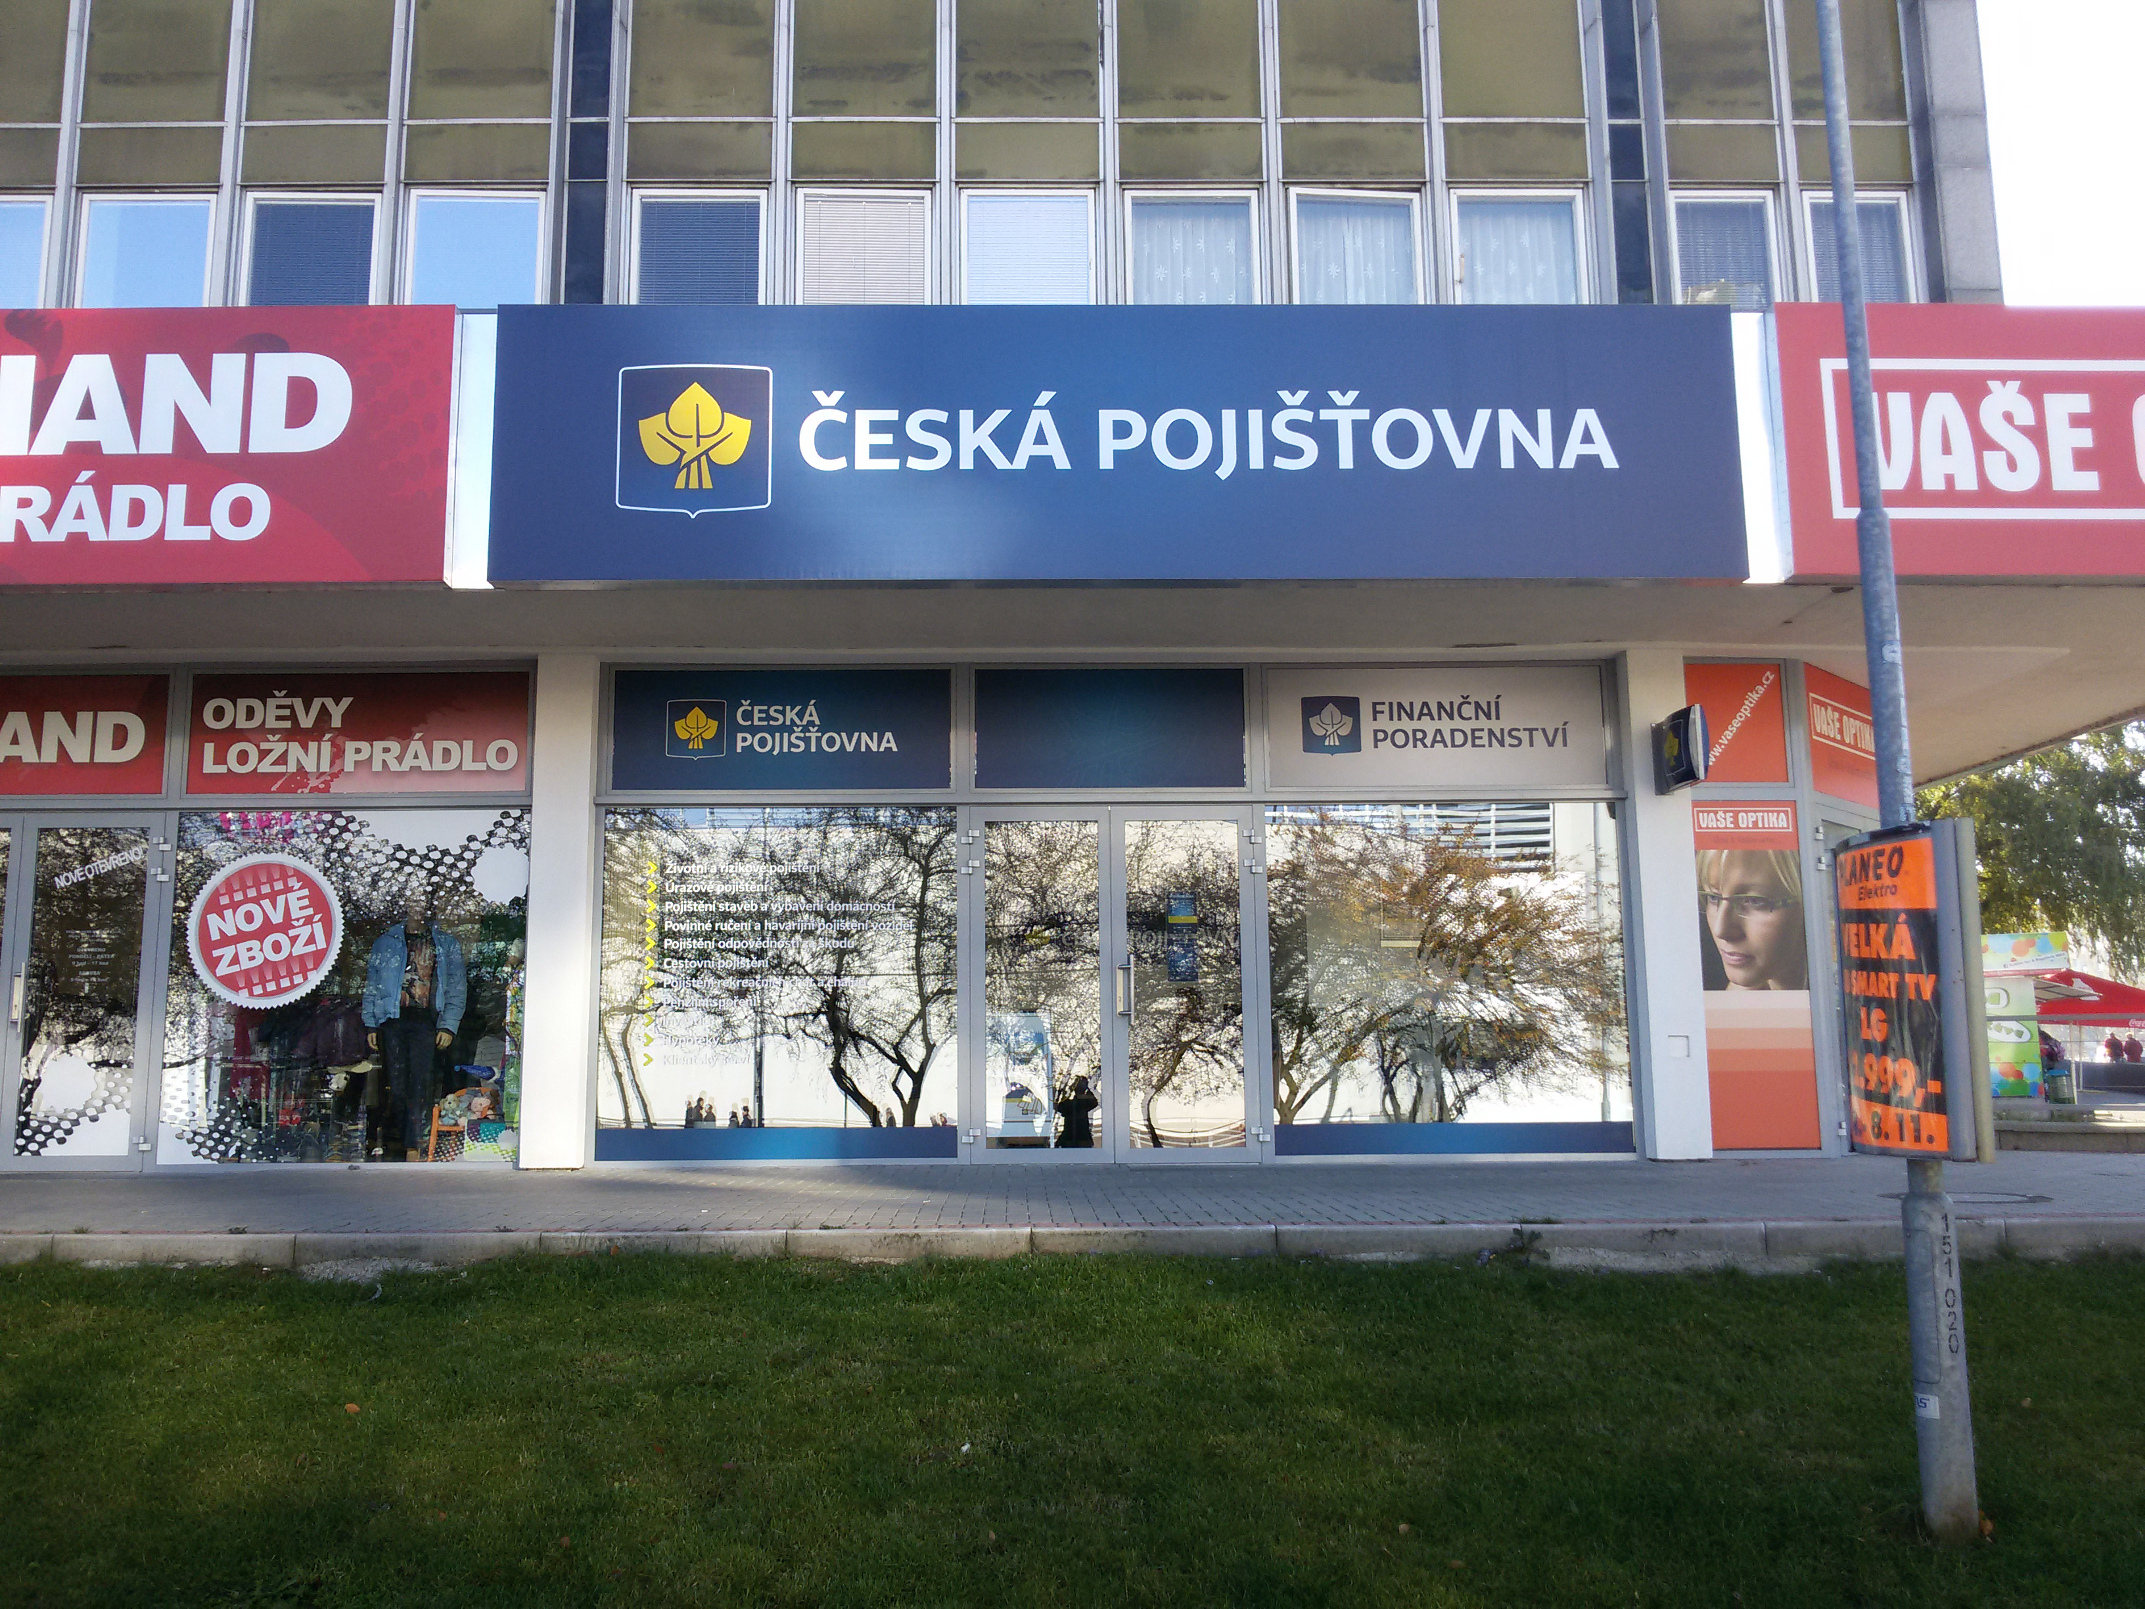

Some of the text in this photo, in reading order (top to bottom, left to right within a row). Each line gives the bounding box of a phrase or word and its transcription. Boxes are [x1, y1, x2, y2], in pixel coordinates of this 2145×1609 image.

[799, 390, 1621, 481] ČESKÁ POJIŠŤOVNA
[1871, 380, 2100, 492] VAŠE
[203, 690, 353, 730] ODĚVY
[736, 700, 820, 727] ČESKÁ
[1371, 694, 1502, 722] FINANČNÍ
[1372, 721, 1569, 750] PORADENSTVÍ
[1813, 704, 1841, 740] VAŠE
[202, 732, 519, 774] LOŽNÍ PRÁDLO
[736, 728, 899, 755] POJIŠŤOVNA
[1698, 811, 1787, 828] VAŠE OPTIKA
[665, 860, 708, 873] Životní
[721, 861, 767, 873] rizikové
[770, 861, 820, 876] pojištění
[665, 880, 768, 895] Úrazové pojištění
[1858, 883, 1898, 901] Elektro
[205, 882, 315, 942] NOVÉ
[664, 901, 716, 914] Pojištění
[719, 901, 757, 912] staveb
[664, 920, 712, 931] Povinné
[715, 920, 752, 931] ručení
[764, 920, 815, 933] havarijní
[818, 919, 868, 933] pojištění
[211, 913, 328, 977] ZBOŽÍ
[664, 938, 715, 951] Pojištění
[718, 938, 799, 951] odpovědnosti
[818, 937, 855, 949] škodu
[664, 957, 768, 971] Cestovní pojištění
[663, 976, 714, 989] Pojištění
[1905, 972, 1937, 1001] TV
[1860, 1006, 1889, 1042] LG
